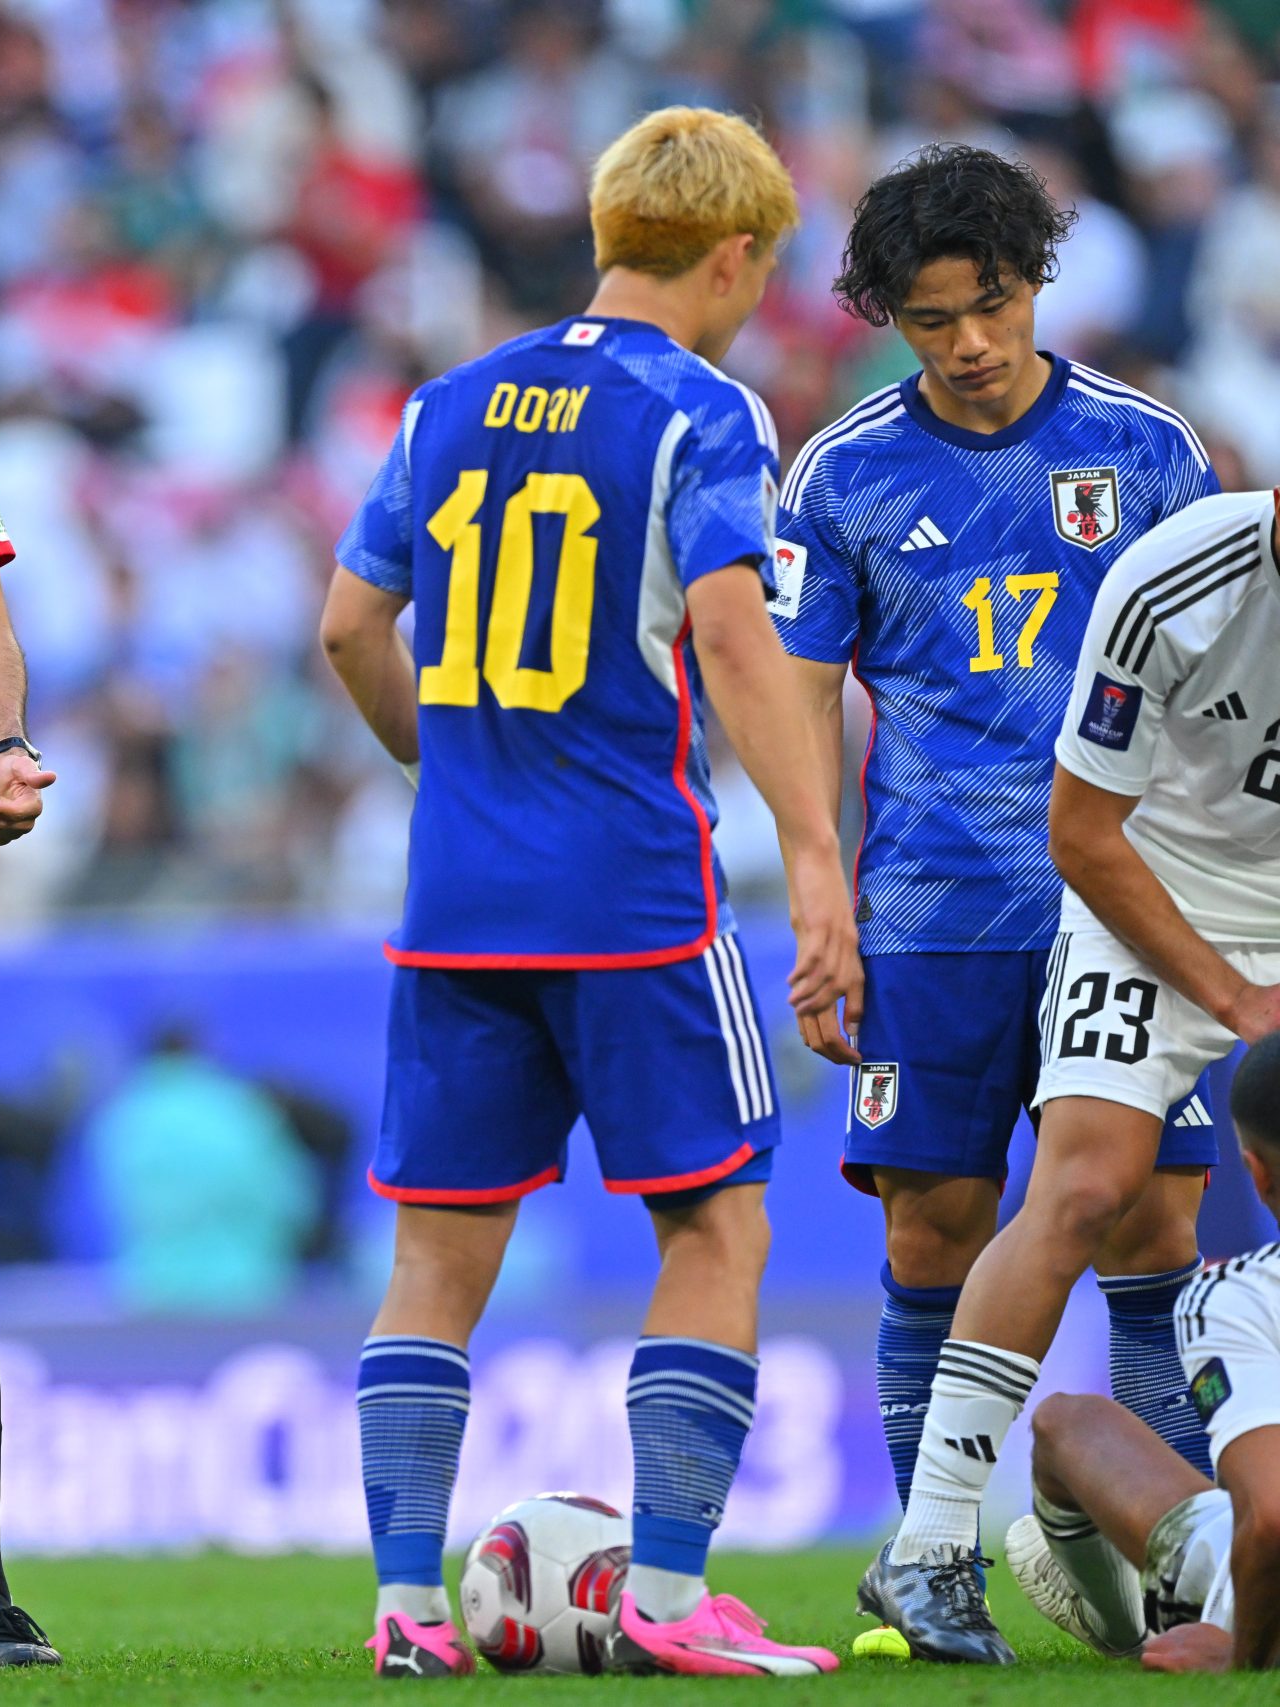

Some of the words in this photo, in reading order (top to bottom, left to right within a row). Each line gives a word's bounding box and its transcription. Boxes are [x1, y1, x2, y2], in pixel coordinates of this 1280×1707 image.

[483, 382, 591, 433] DOAN
[1067, 471, 1100, 480] JAPAN
[1075, 522, 1103, 536] JFA
[419, 469, 601, 713] 10
[961, 571, 1059, 673] 17
[1058, 972, 1158, 1065] 23
